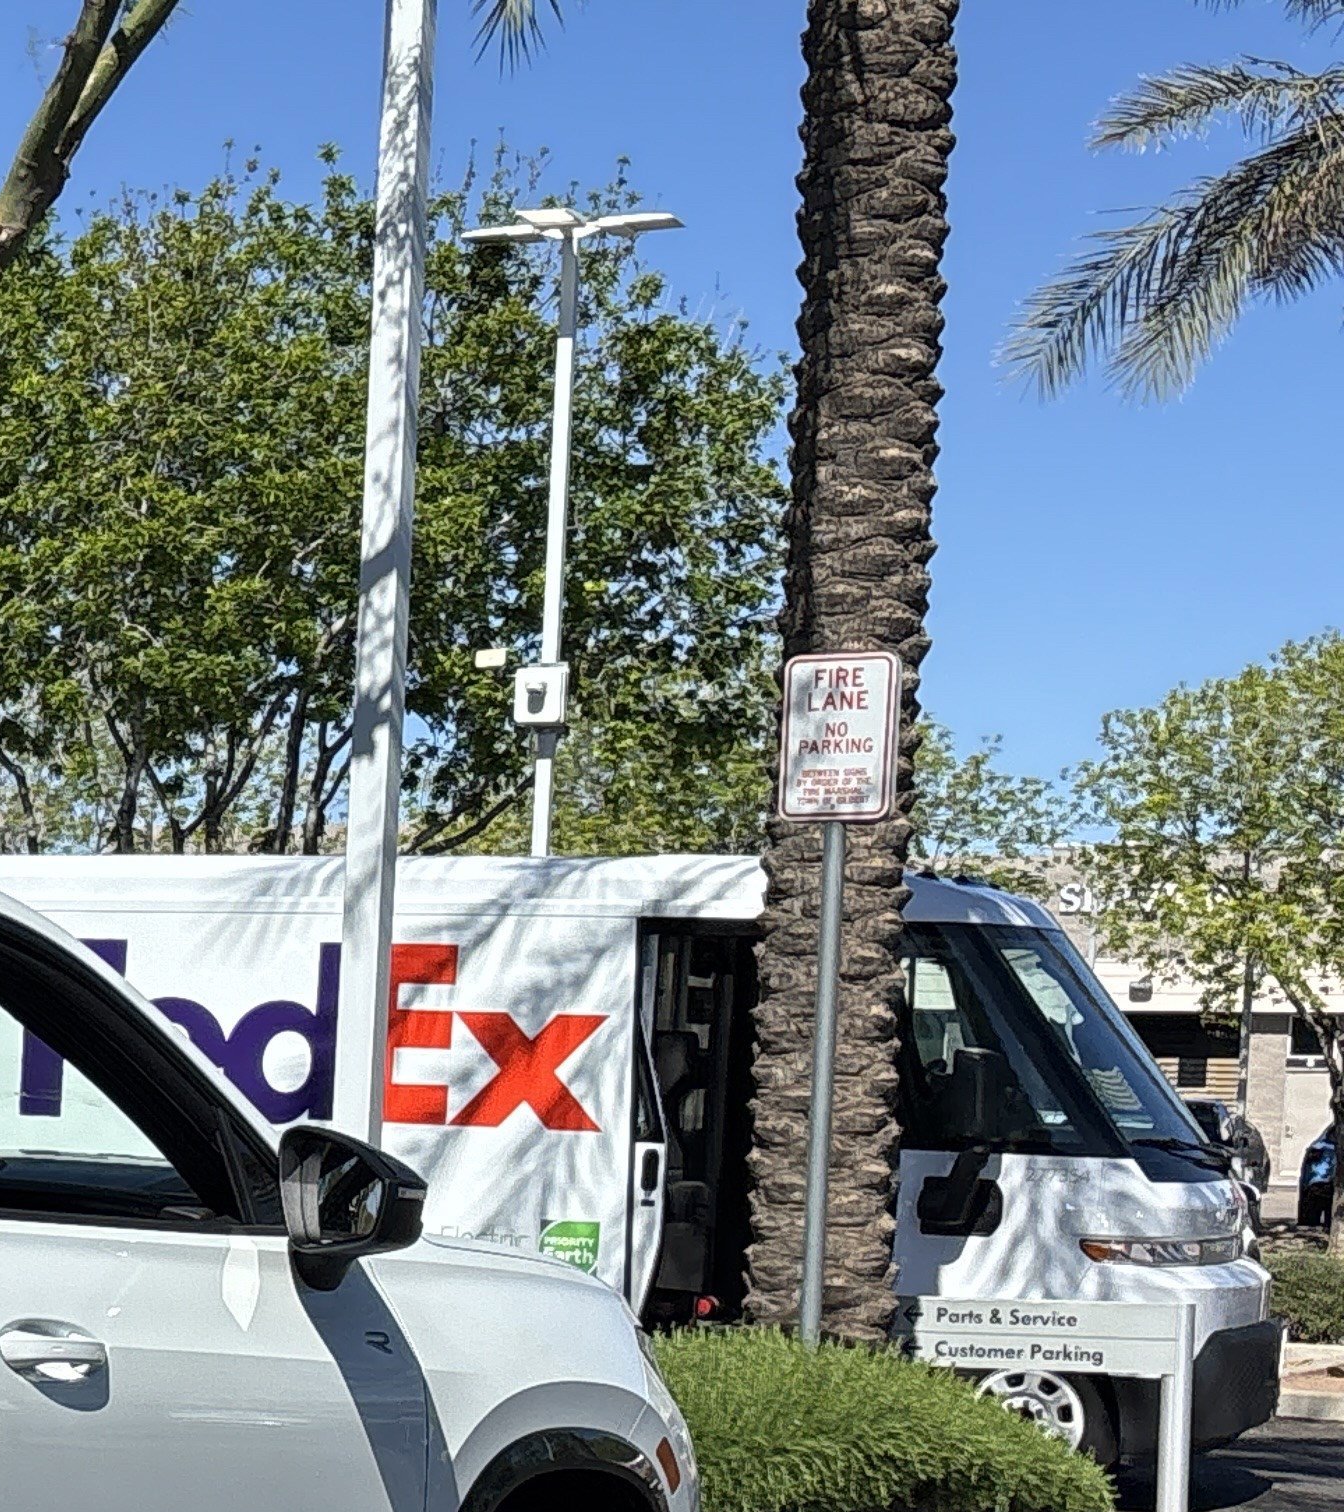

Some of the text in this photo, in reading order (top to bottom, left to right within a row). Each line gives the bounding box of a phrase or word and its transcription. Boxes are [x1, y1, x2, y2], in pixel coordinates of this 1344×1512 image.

[814, 667, 865, 689] FIRE
[807, 690, 869, 712] LANE
[824, 721, 849, 738] NO
[798, 737, 874, 755] PARKING
[543, 1235, 596, 1248] PRIORITY
[542, 1247, 596, 1265] Earth
[936, 1306, 1079, 1327] Parts & Service
[934, 1340, 1104, 1366] Customer Parking
